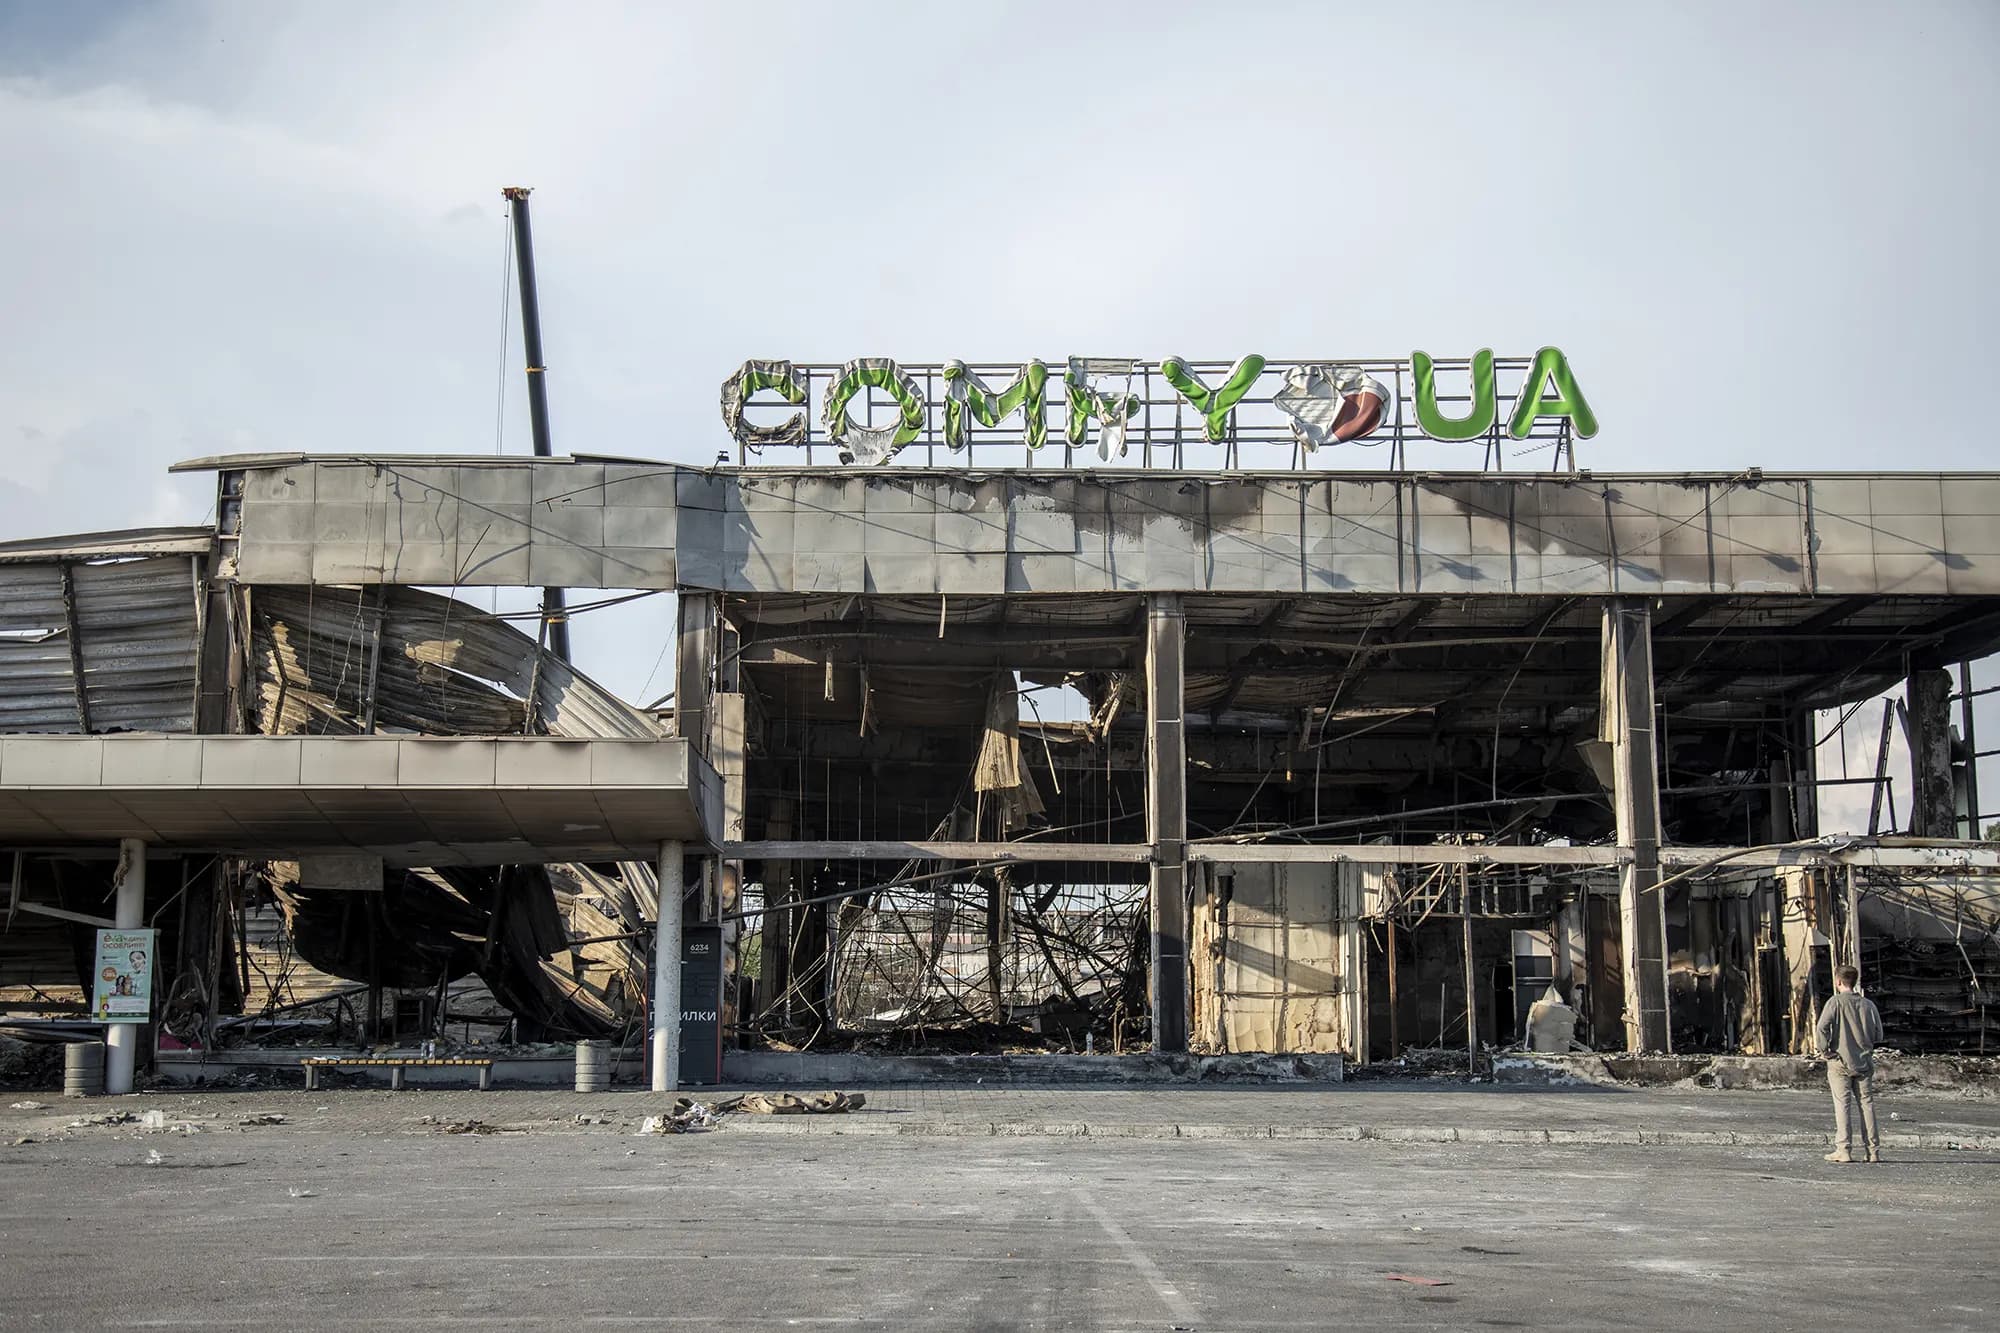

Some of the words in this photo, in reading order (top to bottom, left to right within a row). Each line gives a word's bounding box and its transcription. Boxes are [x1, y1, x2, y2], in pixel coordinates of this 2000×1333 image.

[1408, 346, 1600, 442] UA
[690, 943, 709, 951] 6234
[649, 1011, 717, 1022] пилки
